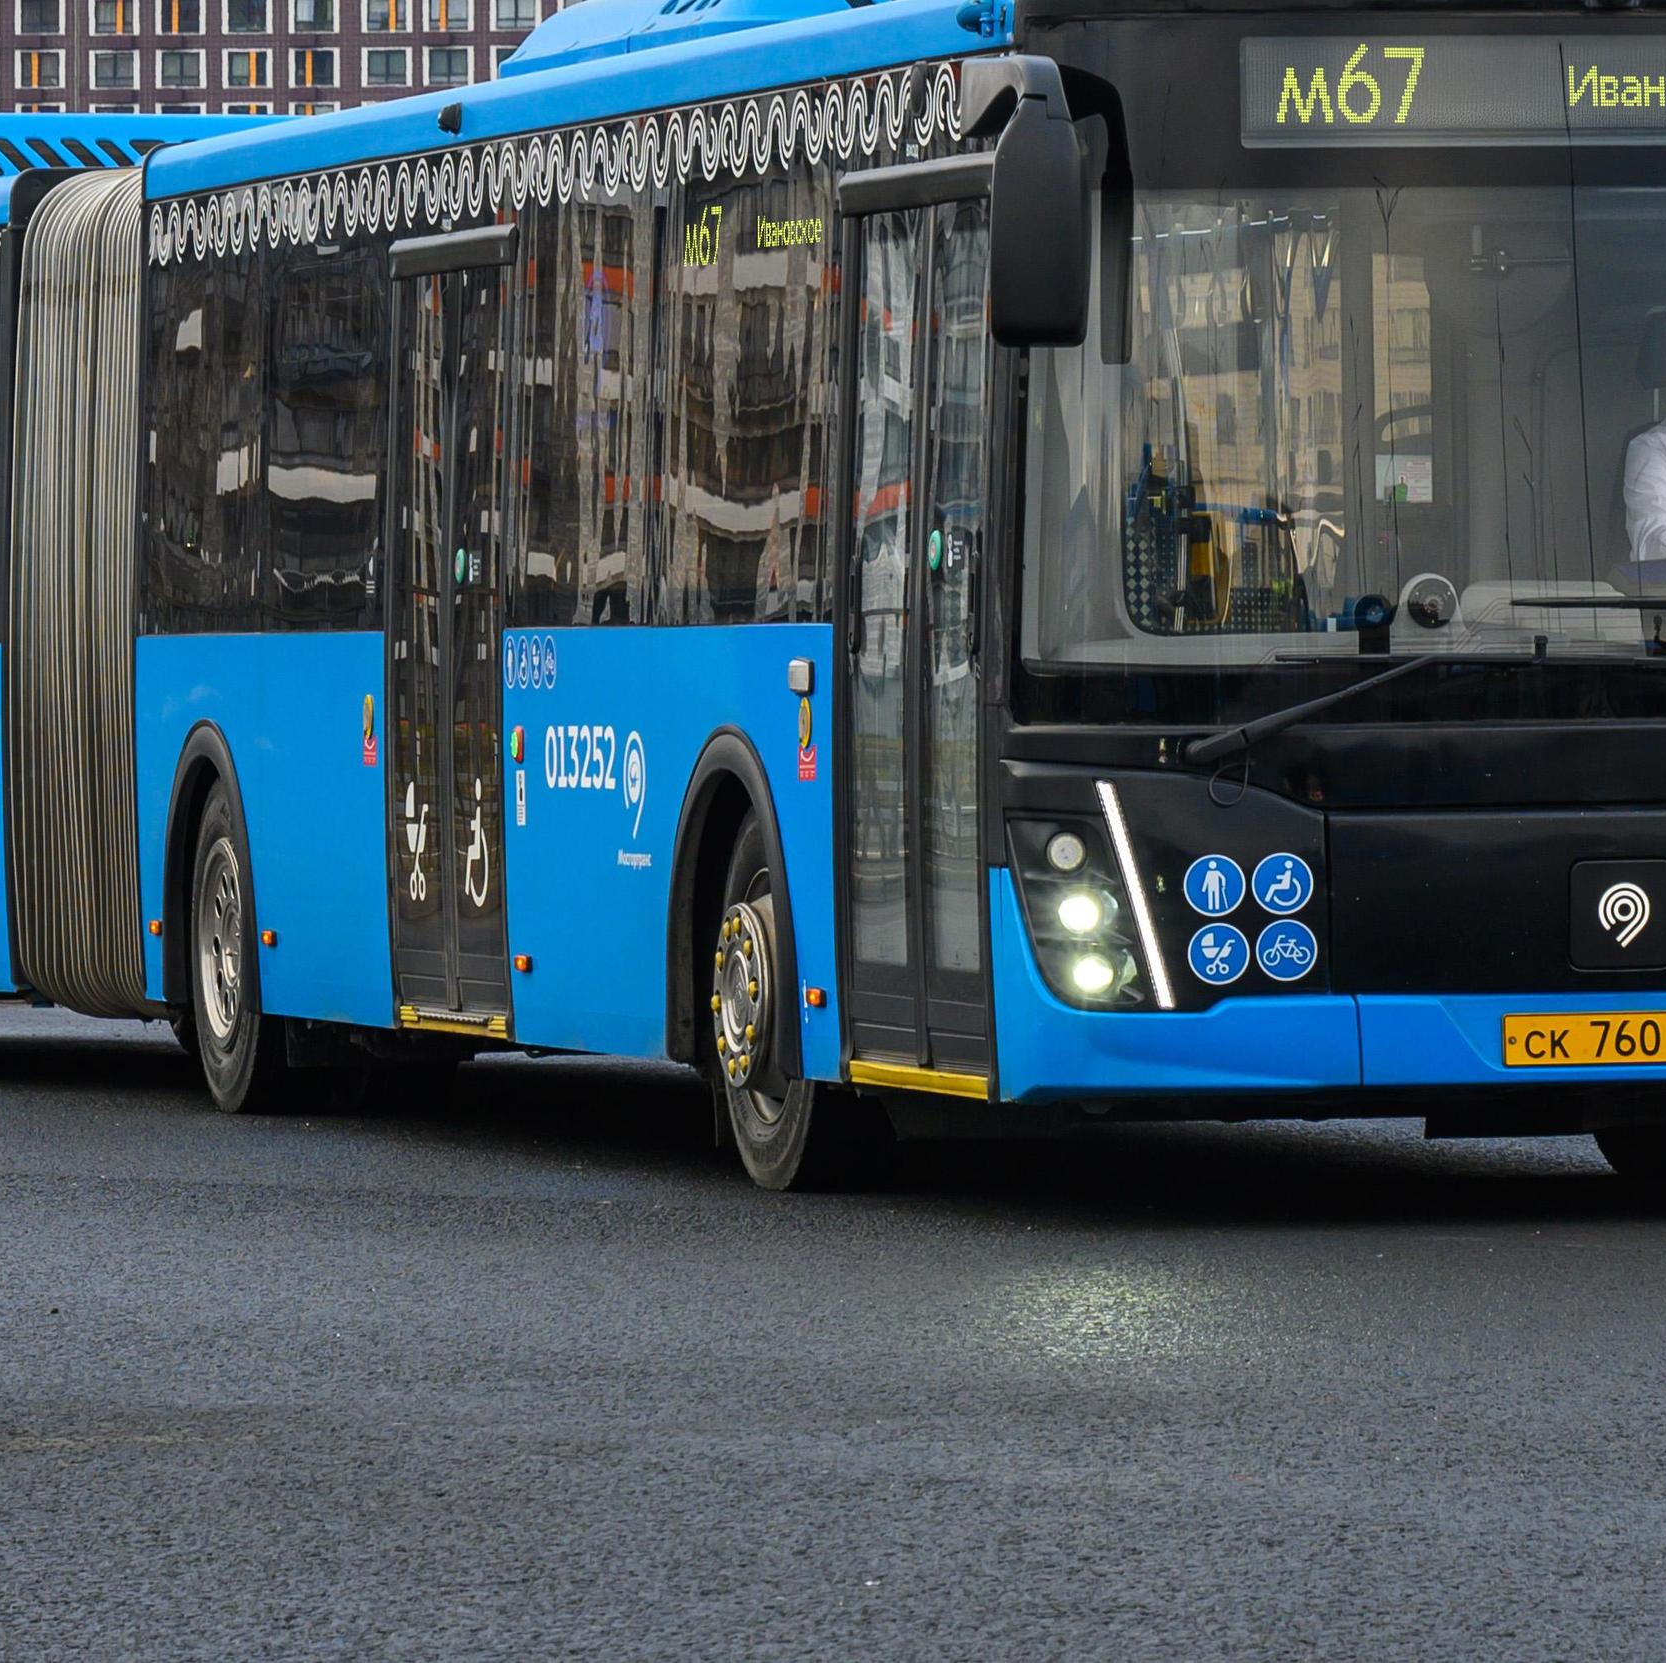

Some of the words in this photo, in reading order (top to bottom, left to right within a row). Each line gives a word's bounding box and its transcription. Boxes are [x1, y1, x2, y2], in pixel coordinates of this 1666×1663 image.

[757, 215, 823, 248] Ивановское
[545, 725, 616, 790] 013252
[1589, 1019, 1661, 1058] 760
